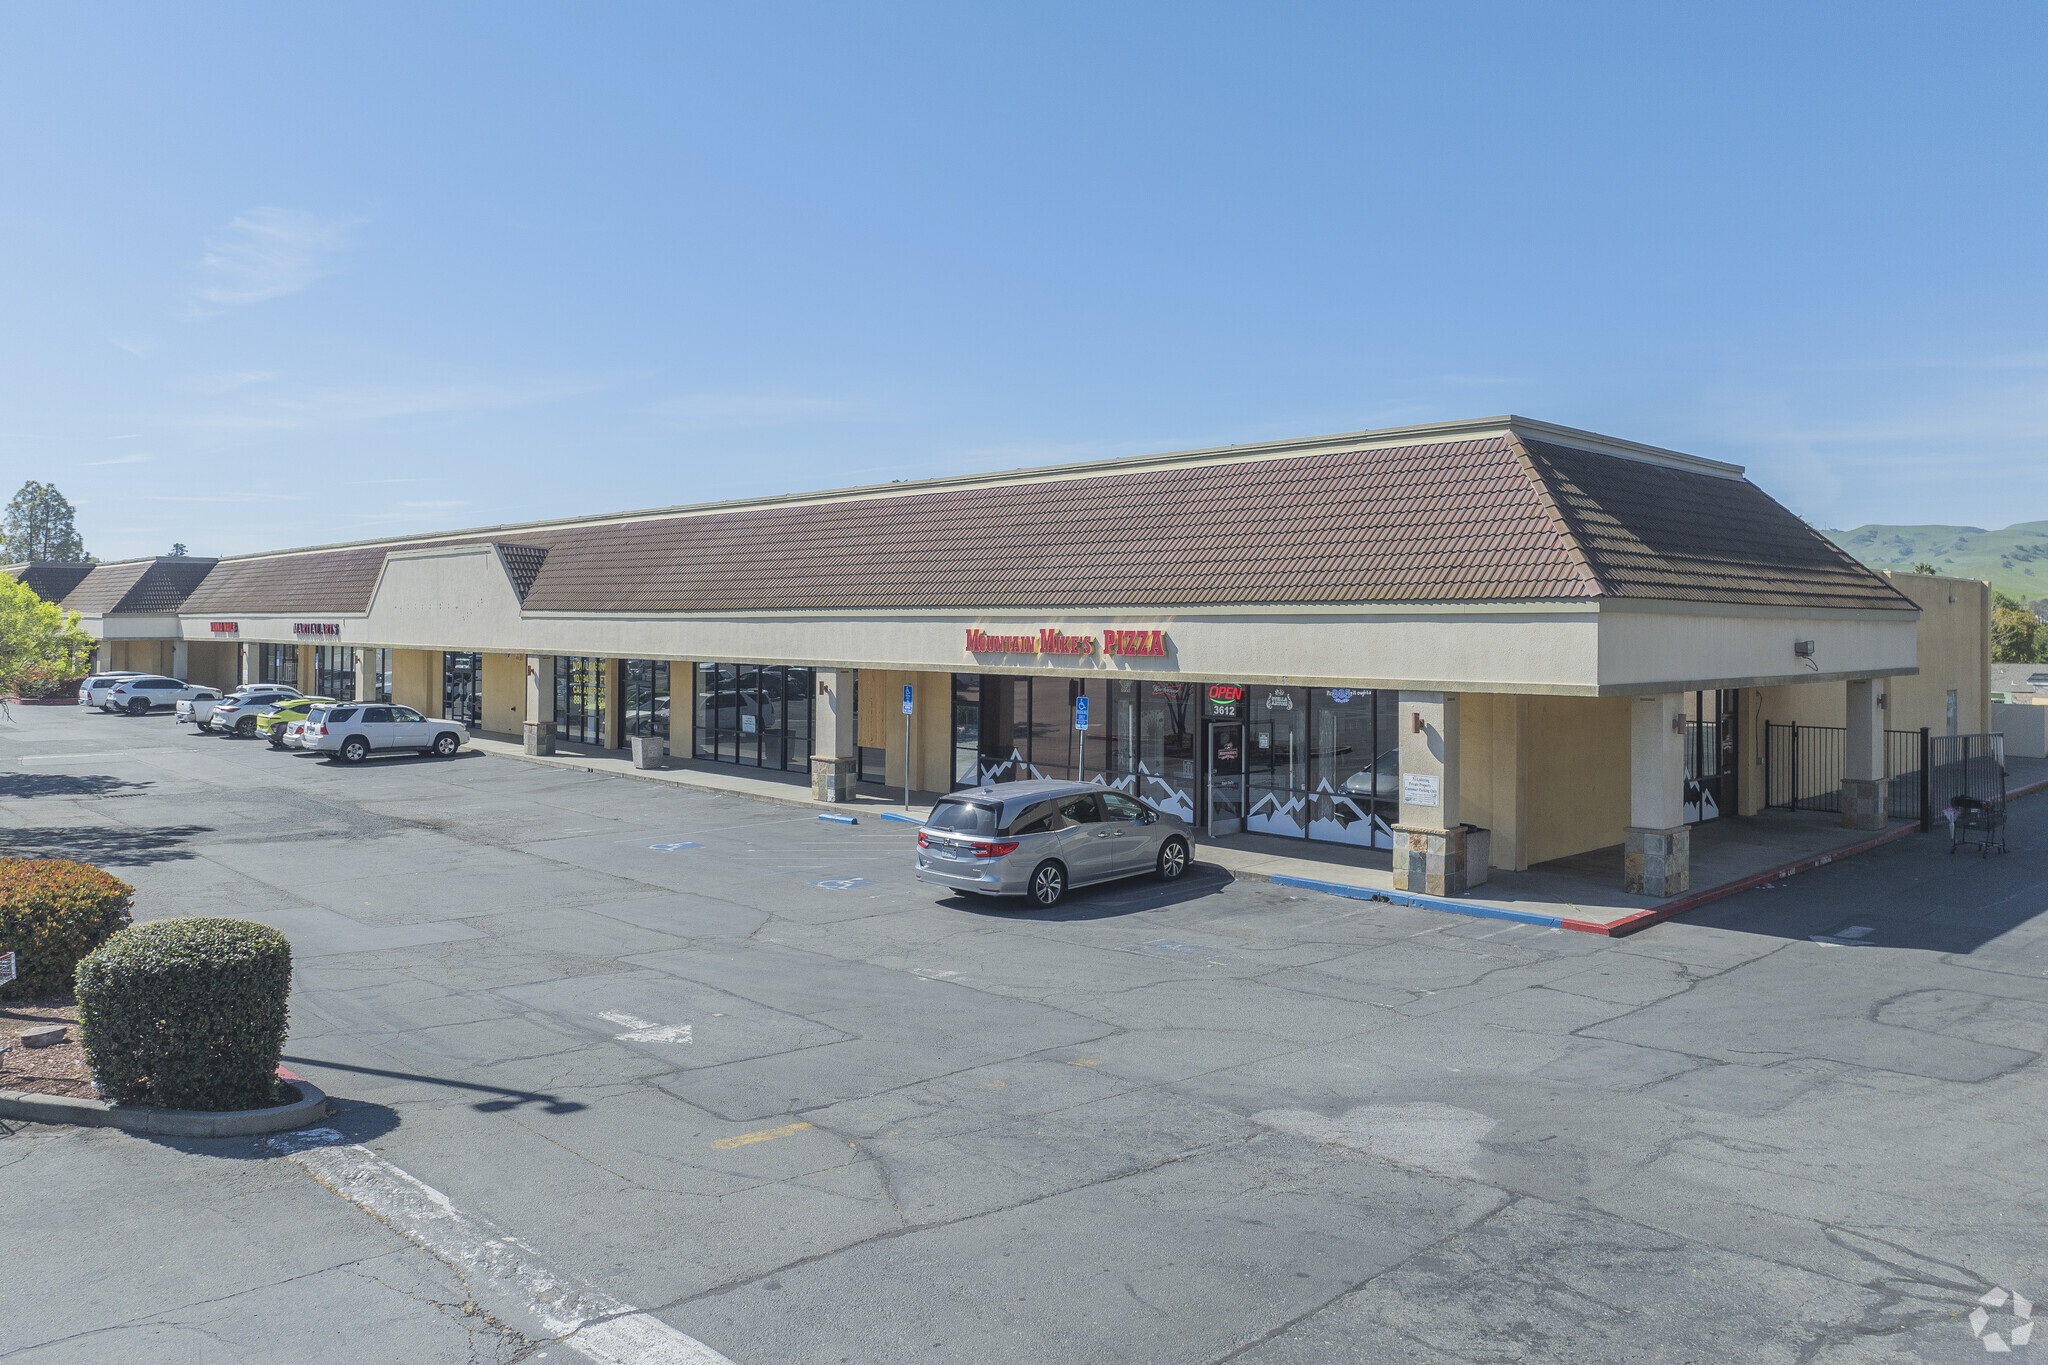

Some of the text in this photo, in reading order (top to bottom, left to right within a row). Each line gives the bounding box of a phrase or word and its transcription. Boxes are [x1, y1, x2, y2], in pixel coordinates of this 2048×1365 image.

[1103, 630, 1167, 657] PIZZA
[1209, 685, 1242, 700] OPEN
[1213, 705, 1235, 715] 3612
